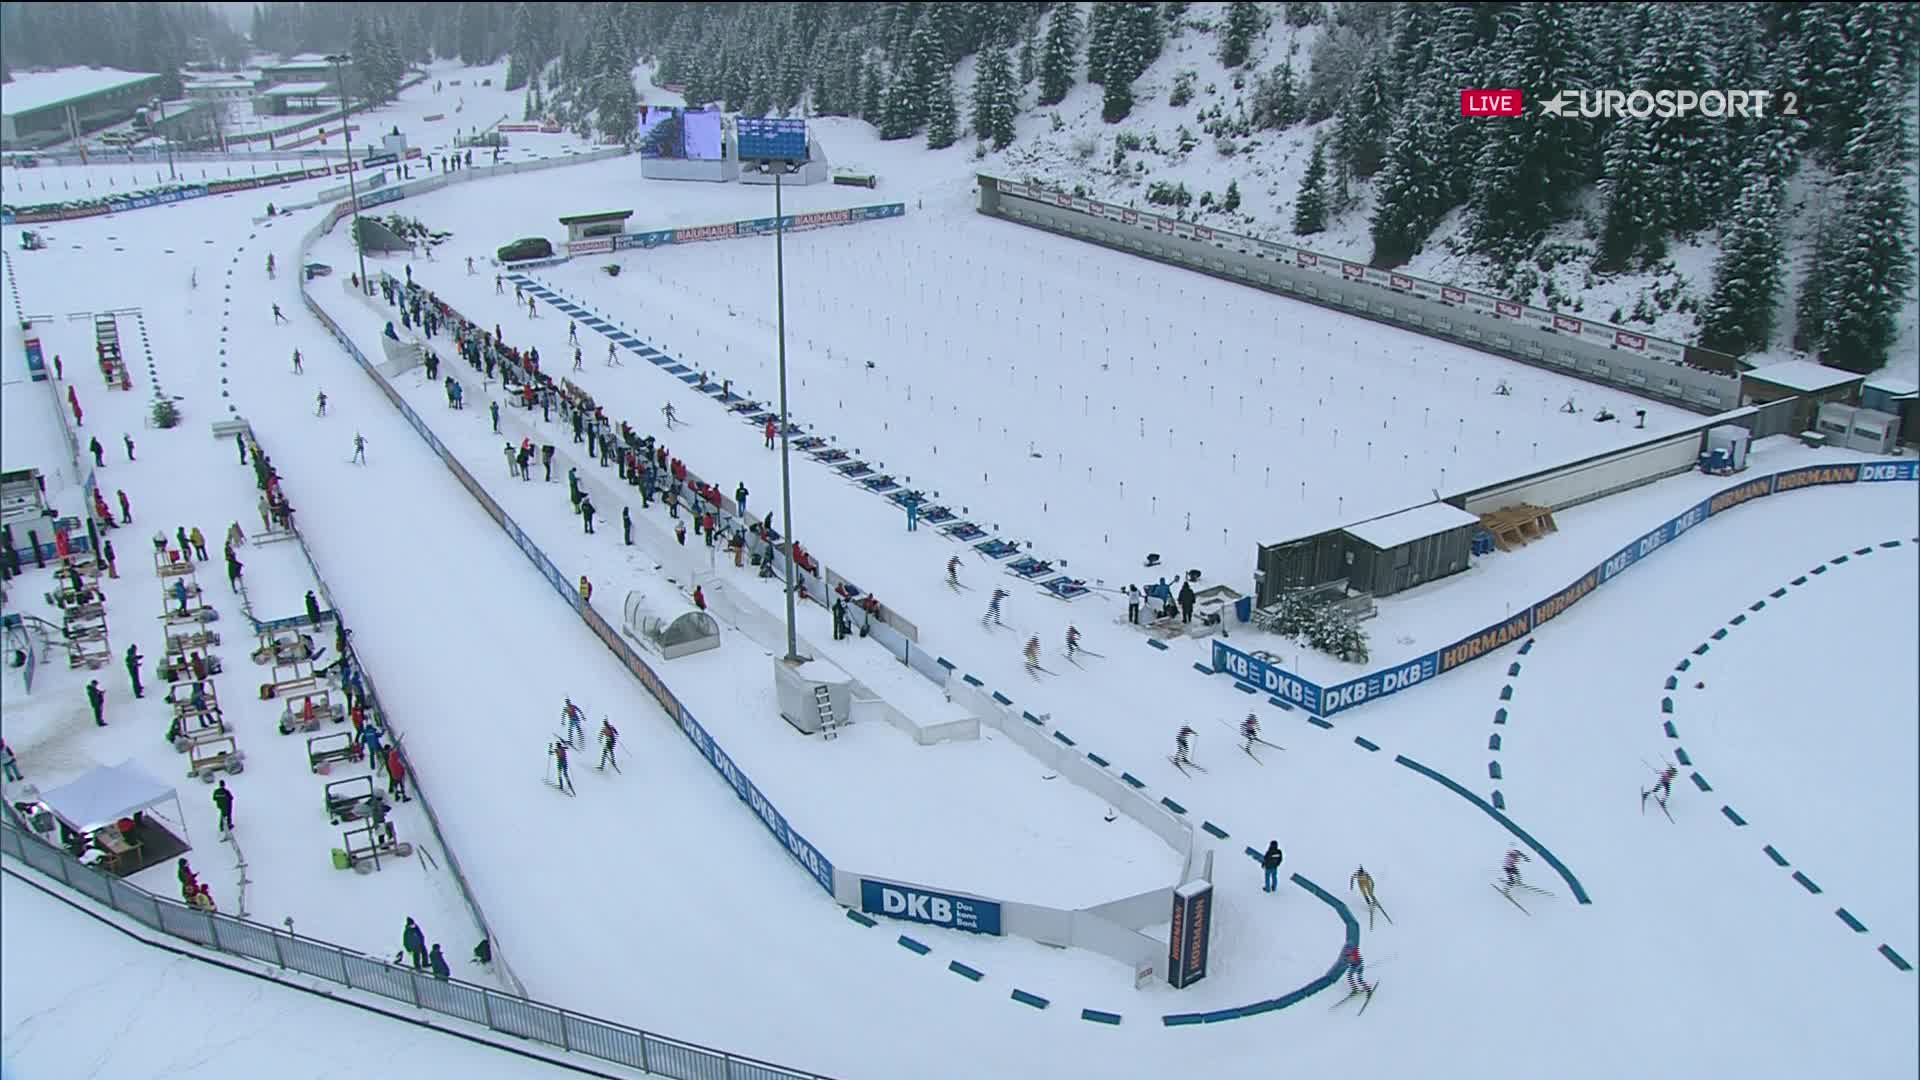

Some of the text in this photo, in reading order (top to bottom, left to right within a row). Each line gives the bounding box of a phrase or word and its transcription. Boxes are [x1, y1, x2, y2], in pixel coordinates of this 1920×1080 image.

[795, 211, 848, 225] BAUHAUS
[676, 224, 735, 240] BAUHAUS
[1863, 465, 1898, 480] DKB
[1605, 552, 1627, 579] DKB
[1264, 670, 1303, 702] DKB
[1326, 686, 1366, 711] DKB
[1382, 665, 1421, 693] DKB
[749, 785, 776, 831] DKB
[787, 827, 819, 876] DKB
[882, 887, 953, 923] DKB
[956, 901, 974, 912] Das
[956, 909, 978, 920] kann
[956, 918, 978, 929] Bank
